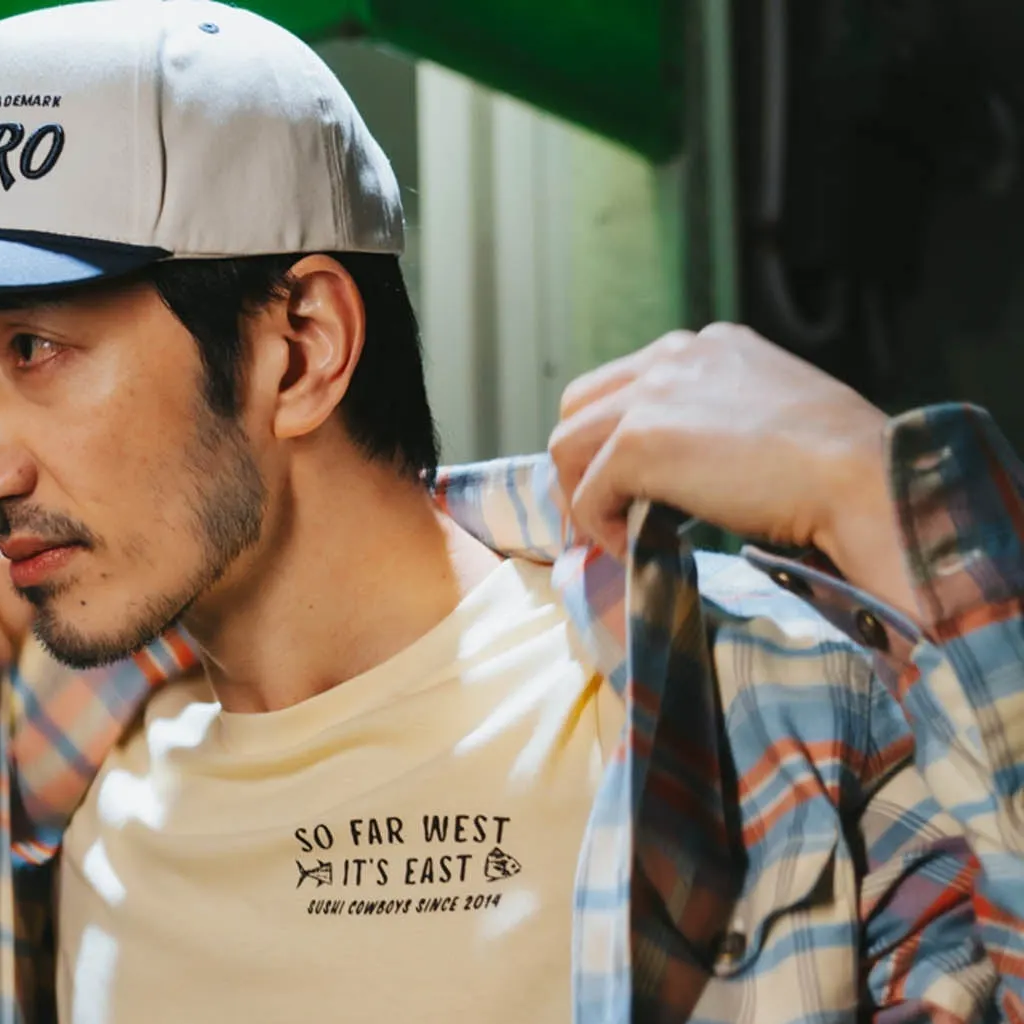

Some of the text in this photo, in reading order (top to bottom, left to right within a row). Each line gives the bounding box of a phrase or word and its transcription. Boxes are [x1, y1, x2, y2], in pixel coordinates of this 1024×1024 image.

[294, 815, 511, 852] SO FAR WEST
[343, 854, 473, 886] IT'S EAST
[307, 893, 502, 916] SUSHI COWBOYS SINCE 2014
